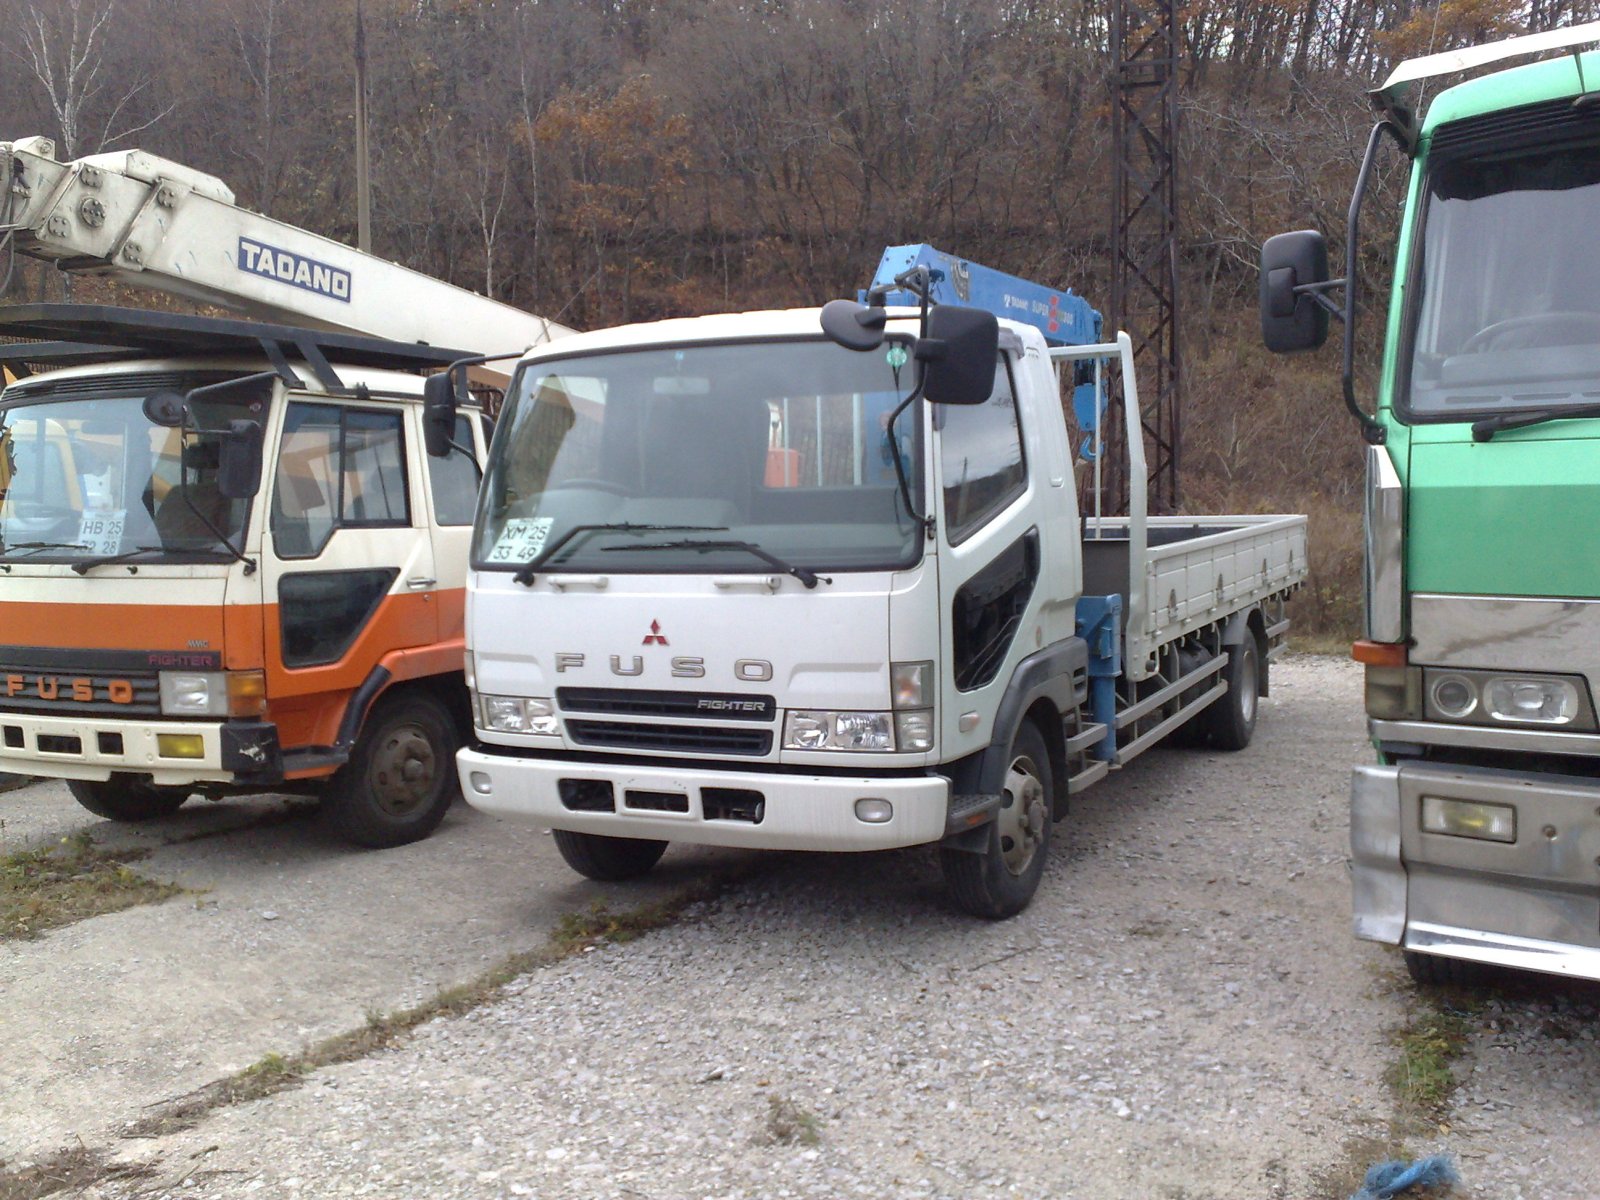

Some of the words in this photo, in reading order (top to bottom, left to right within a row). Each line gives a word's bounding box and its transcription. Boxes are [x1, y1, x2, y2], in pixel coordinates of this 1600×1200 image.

[241, 241, 348, 298] TADANO
[108, 521, 122, 534] 25
[528, 526, 547, 540] 25
[102, 541, 117, 554] 28
[149, 654, 213, 666] FIGHTER
[555, 652, 773, 682] FUSO
[7, 674, 133, 704] FUSO
[697, 699, 765, 713] FIGHTER
